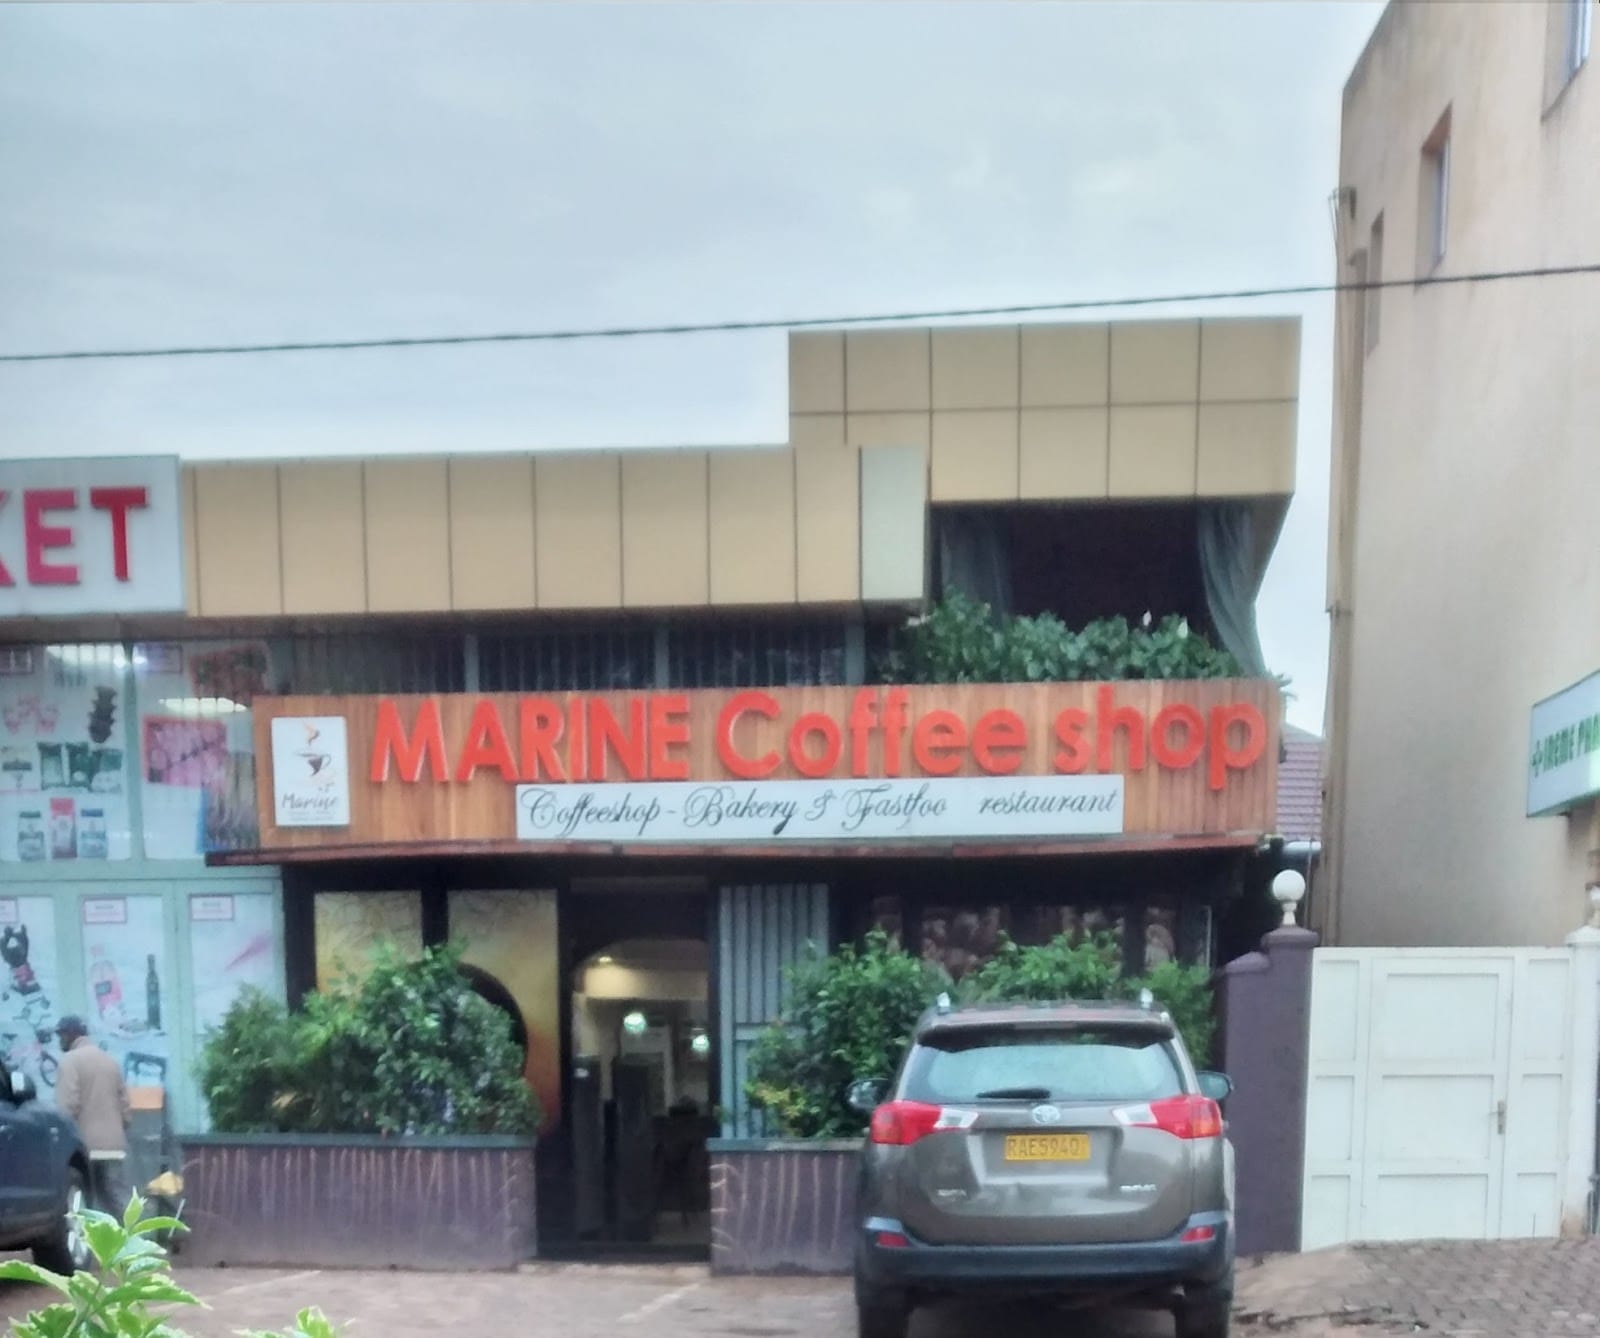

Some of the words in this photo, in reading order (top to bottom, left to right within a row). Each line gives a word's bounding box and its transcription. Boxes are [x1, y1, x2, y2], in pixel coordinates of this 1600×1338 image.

[0, 486, 149, 586] ET
[370, 693, 692, 784] MARINE
[716, 687, 1028, 779] Coffee
[1052, 685, 1267, 791] shop
[683, 786, 797, 836] Bakery
[979, 787, 1119, 815] restaurant
